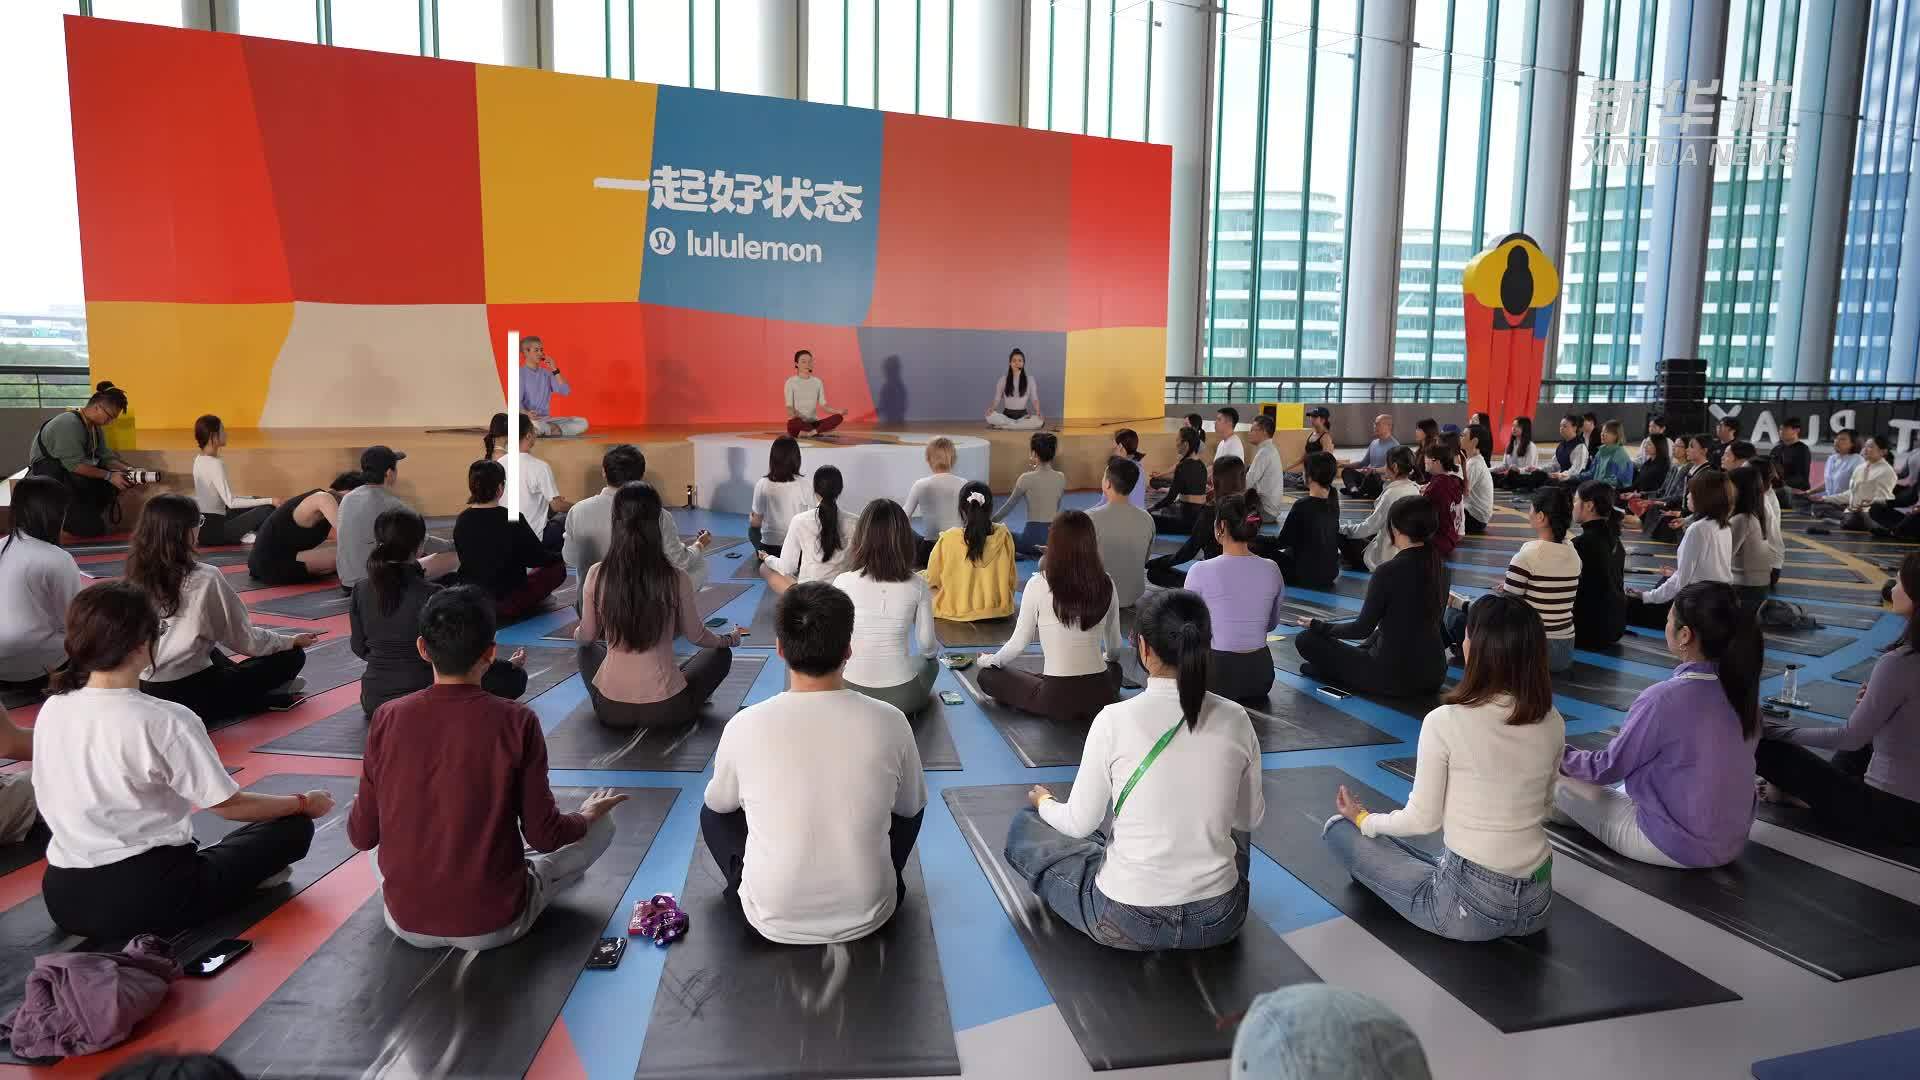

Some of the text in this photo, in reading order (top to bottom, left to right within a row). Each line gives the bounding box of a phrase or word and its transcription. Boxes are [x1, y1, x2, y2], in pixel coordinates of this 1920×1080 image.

[593, 165, 864, 223] 一起好状态
[687, 229, 823, 263] lululemon
